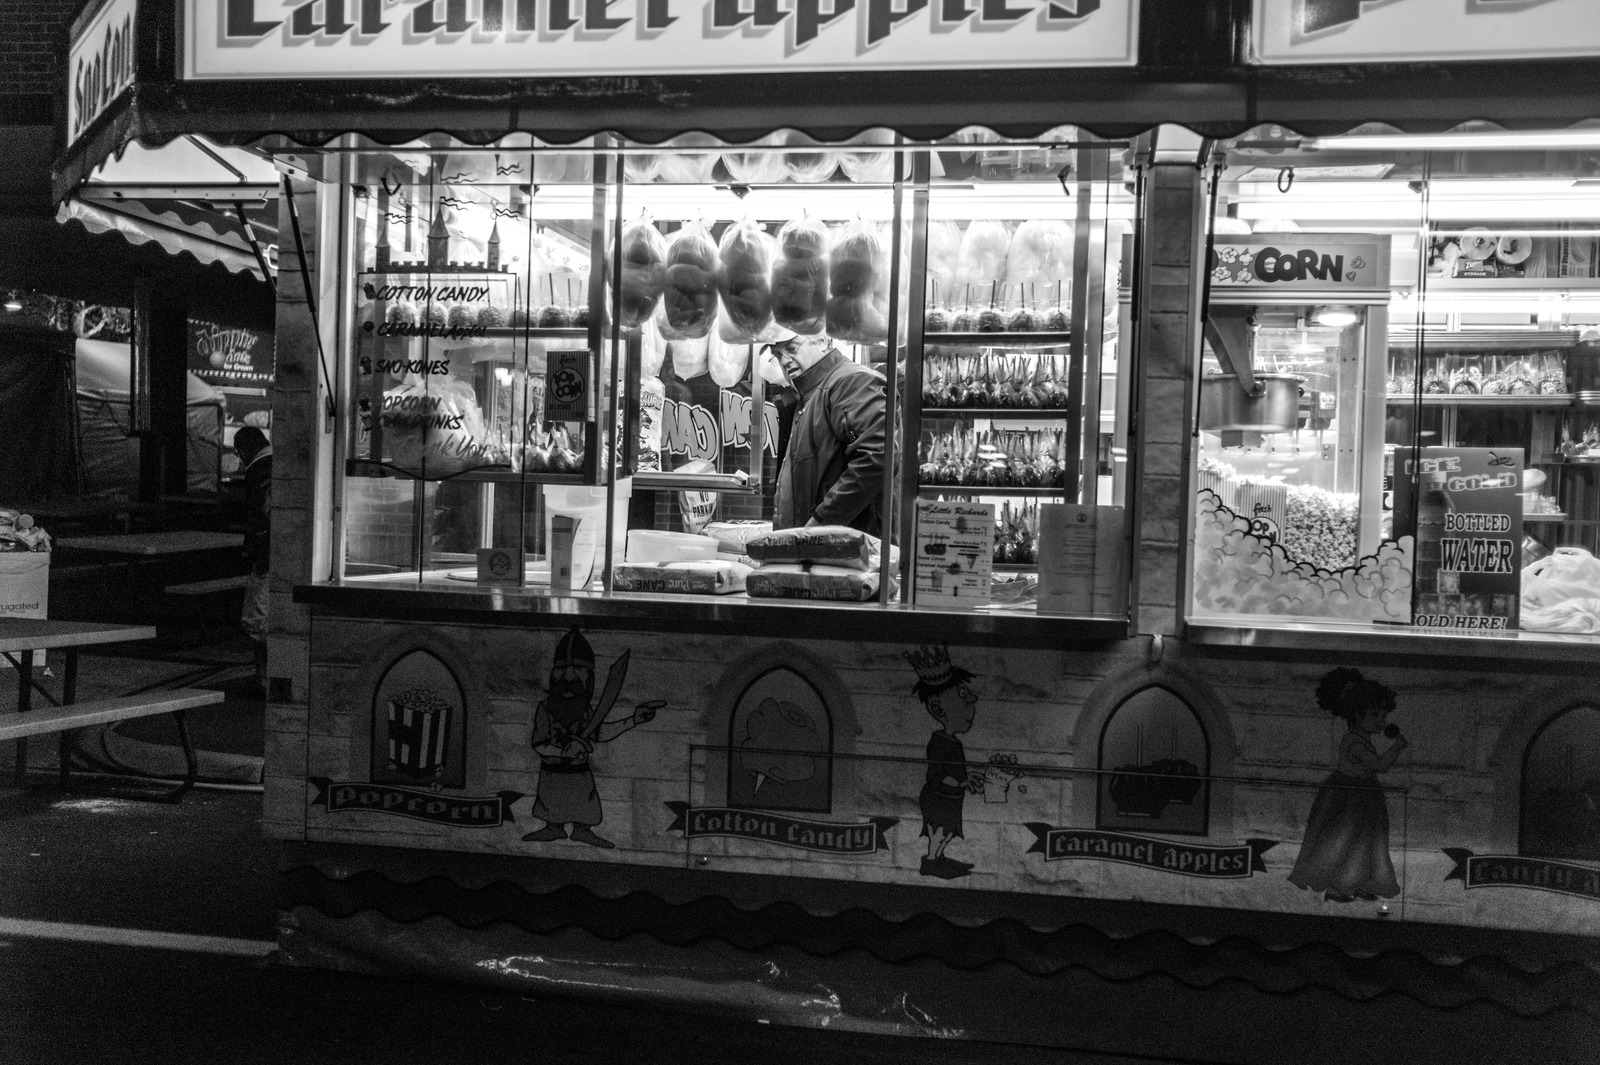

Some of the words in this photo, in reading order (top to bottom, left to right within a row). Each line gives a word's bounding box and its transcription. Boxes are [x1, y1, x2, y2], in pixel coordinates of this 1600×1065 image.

[1255, 246, 1343, 282] CORN
[376, 285, 438, 301] COTTON
[437, 286, 490, 302] CANDY
[377, 321, 449, 340] CARAMEL
[375, 359, 450, 375] SNO-KONES
[929, 505, 951, 515] Little
[955, 507, 988, 516] Richards
[1253, 503, 1271, 517] fresh
[1445, 513, 1511, 532] BOTTLED
[1441, 538, 1514, 574] WATER
[637, 579, 666, 591] CANE
[1416, 614, 1450, 628] OLD
[1455, 616, 1508, 629] HERE!
[335, 786, 492, 820] Popcorn
[694, 812, 777, 836] Cotton
[788, 823, 870, 849] Candy
